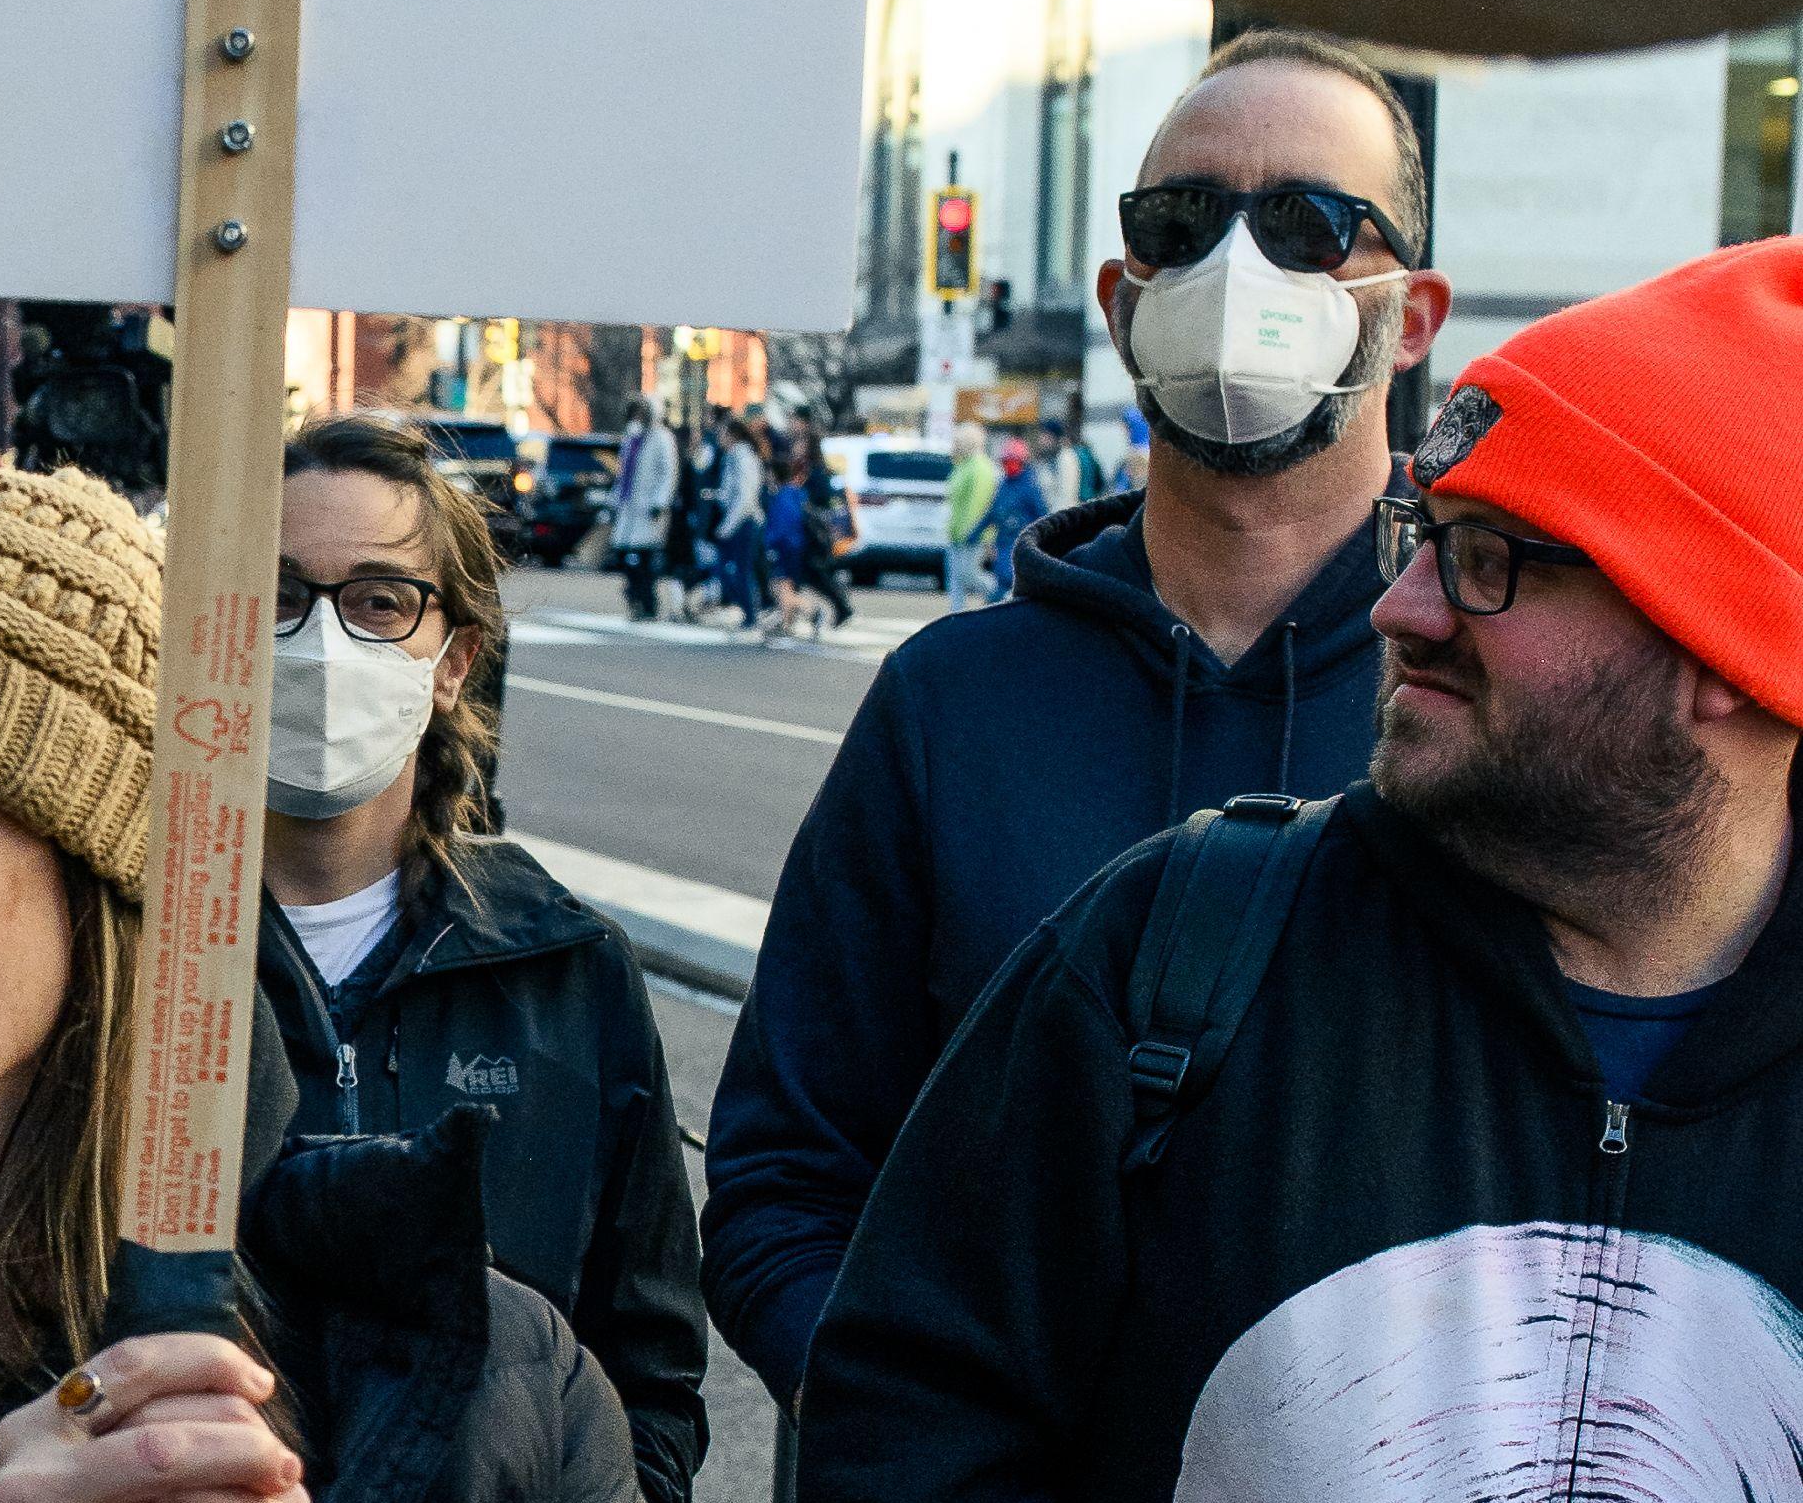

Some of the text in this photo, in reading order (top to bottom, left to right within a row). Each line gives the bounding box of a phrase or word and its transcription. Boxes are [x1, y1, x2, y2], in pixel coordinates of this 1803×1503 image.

[231, 704, 251, 753] FSC
[185, 871, 209, 954] painting
[184, 960, 201, 1004] your
[181, 1012, 196, 1036] up
[176, 1043, 195, 1085] pick
[469, 1066, 517, 1086] REI
[172, 1091, 189, 1110] to
[166, 1116, 191, 1176] forget
[158, 1182, 181, 1235] Don't
